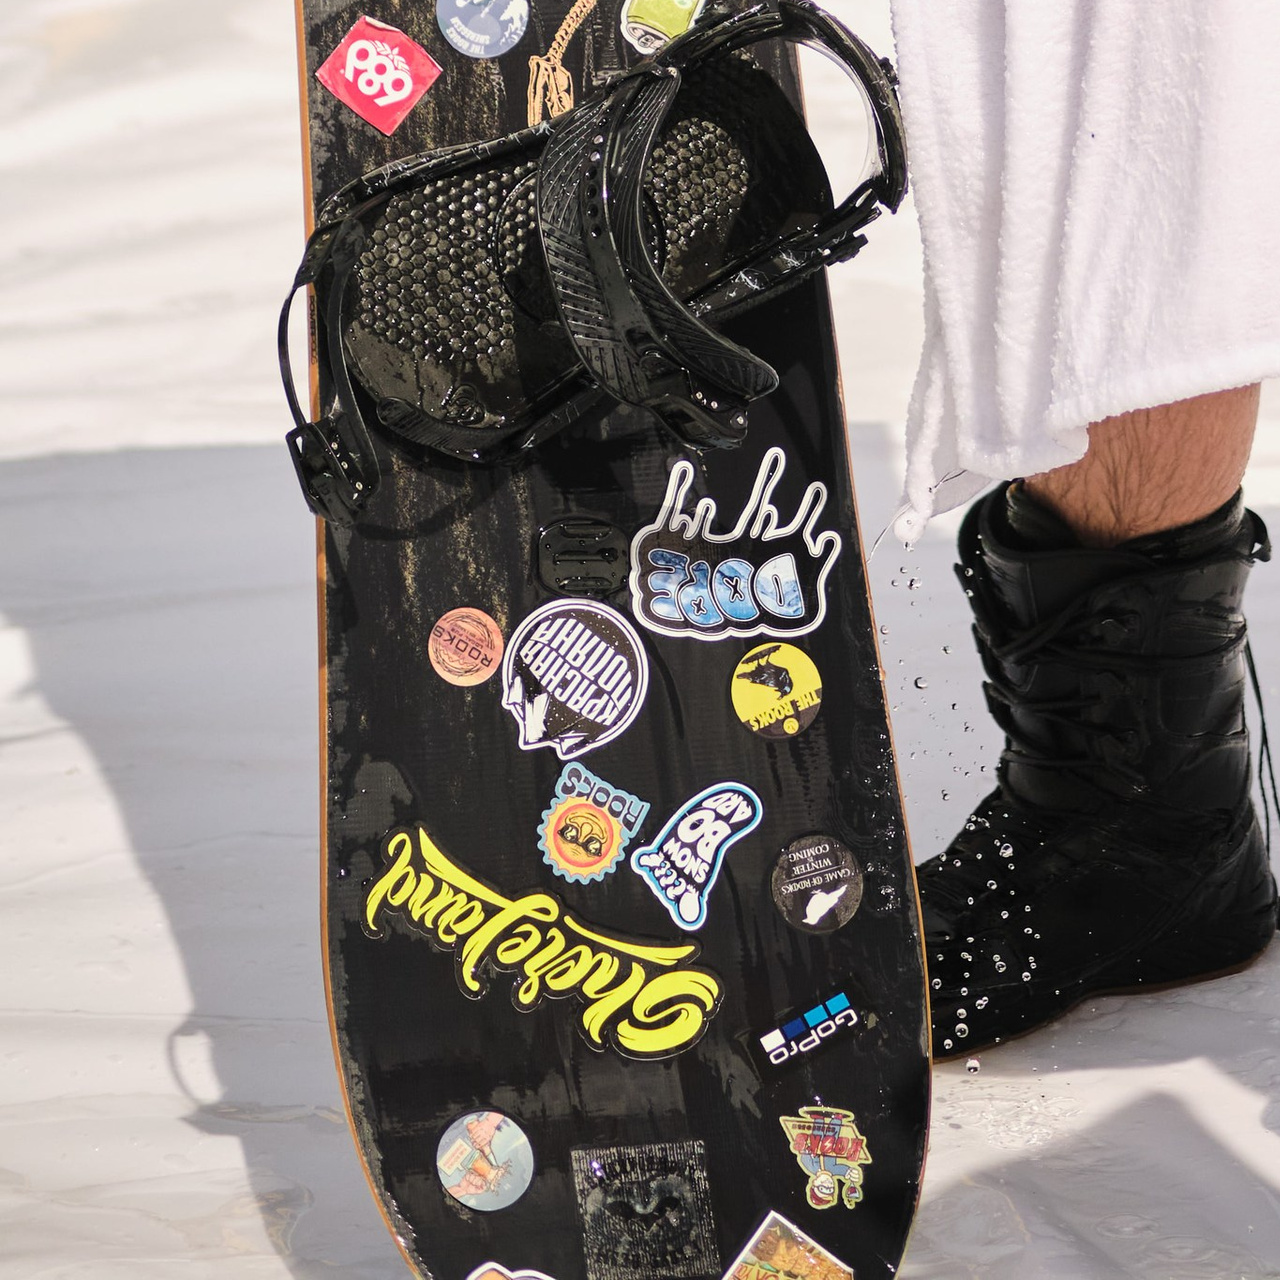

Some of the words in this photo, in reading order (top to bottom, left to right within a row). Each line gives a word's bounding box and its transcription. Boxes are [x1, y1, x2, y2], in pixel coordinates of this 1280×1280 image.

[648, 548, 805, 625] DOPE
[433, 625, 493, 668] ROOKS
[520, 639, 619, 726] КРАСНАЯ
[530, 620, 632, 712] ПОЛЯНА
[749, 701, 794, 731] ROOKS
[795, 690, 822, 711] THE
[561, 767, 650, 833] ROOKS
[663, 838, 709, 884] SNOW
[788, 843, 829, 862] COMING
[793, 858, 832, 876] WINTER
[782, 880, 810, 895] ROOKS
[824, 868, 850, 882] GAME
[768, 1008, 858, 1065] GoPro
[793, 1132, 864, 1165] ROOKS
